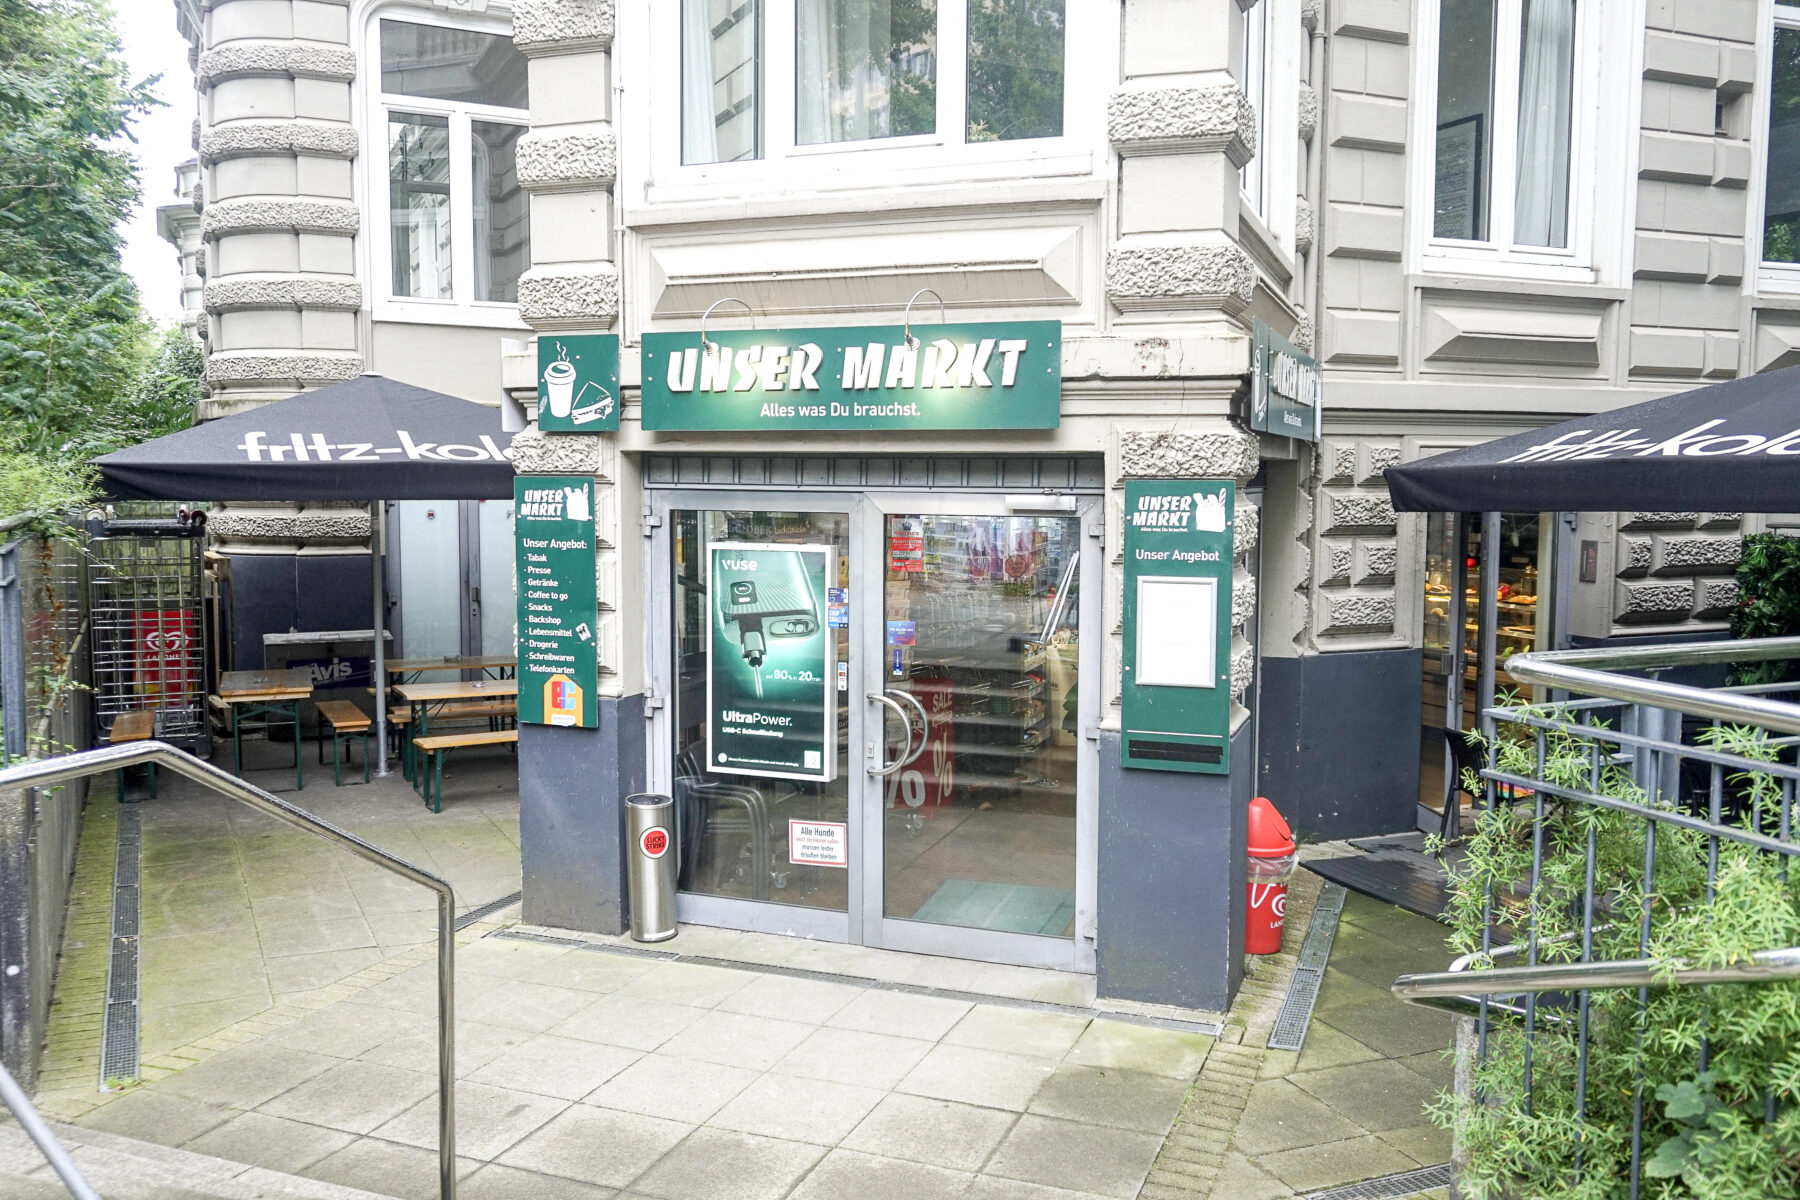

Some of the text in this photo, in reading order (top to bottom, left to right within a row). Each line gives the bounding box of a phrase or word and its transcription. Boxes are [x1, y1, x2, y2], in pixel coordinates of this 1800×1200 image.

[667, 338, 1027, 393] UNSER MARKT
[760, 401, 921, 417] Alles was Du brauchst.
[237, 430, 513, 462] fritz-kol
[524, 489, 564, 503] UNSER
[1138, 495, 1192, 511] UNSER
[520, 502, 564, 516] MARKT
[1132, 511, 1191, 527] MARKT
[523, 538, 588, 551] Unser Angebot:
[527, 553, 547, 562] Tabak
[1135, 548, 1220, 564] Unser Angebot
[527, 565, 551, 574] Presse
[527, 578, 559, 587] Getränke
[528, 590, 568, 602] Coffee to go
[528, 603, 553, 612] Snacks
[528, 615, 561, 626] Backshop
[529, 627, 573, 637] Lebensmittel
[529, 640, 558, 650] Drogerie
[529, 652, 575, 662] Schreibwaren
[529, 664, 575, 674] Telefonkarten
[722, 710, 793, 727] UltraPower.
[722, 726, 741, 734] USB-C
[800, 826, 835, 838] Alle Hunde
[646, 835, 665, 844] LUCKY
[645, 841, 665, 851] STRIKE
